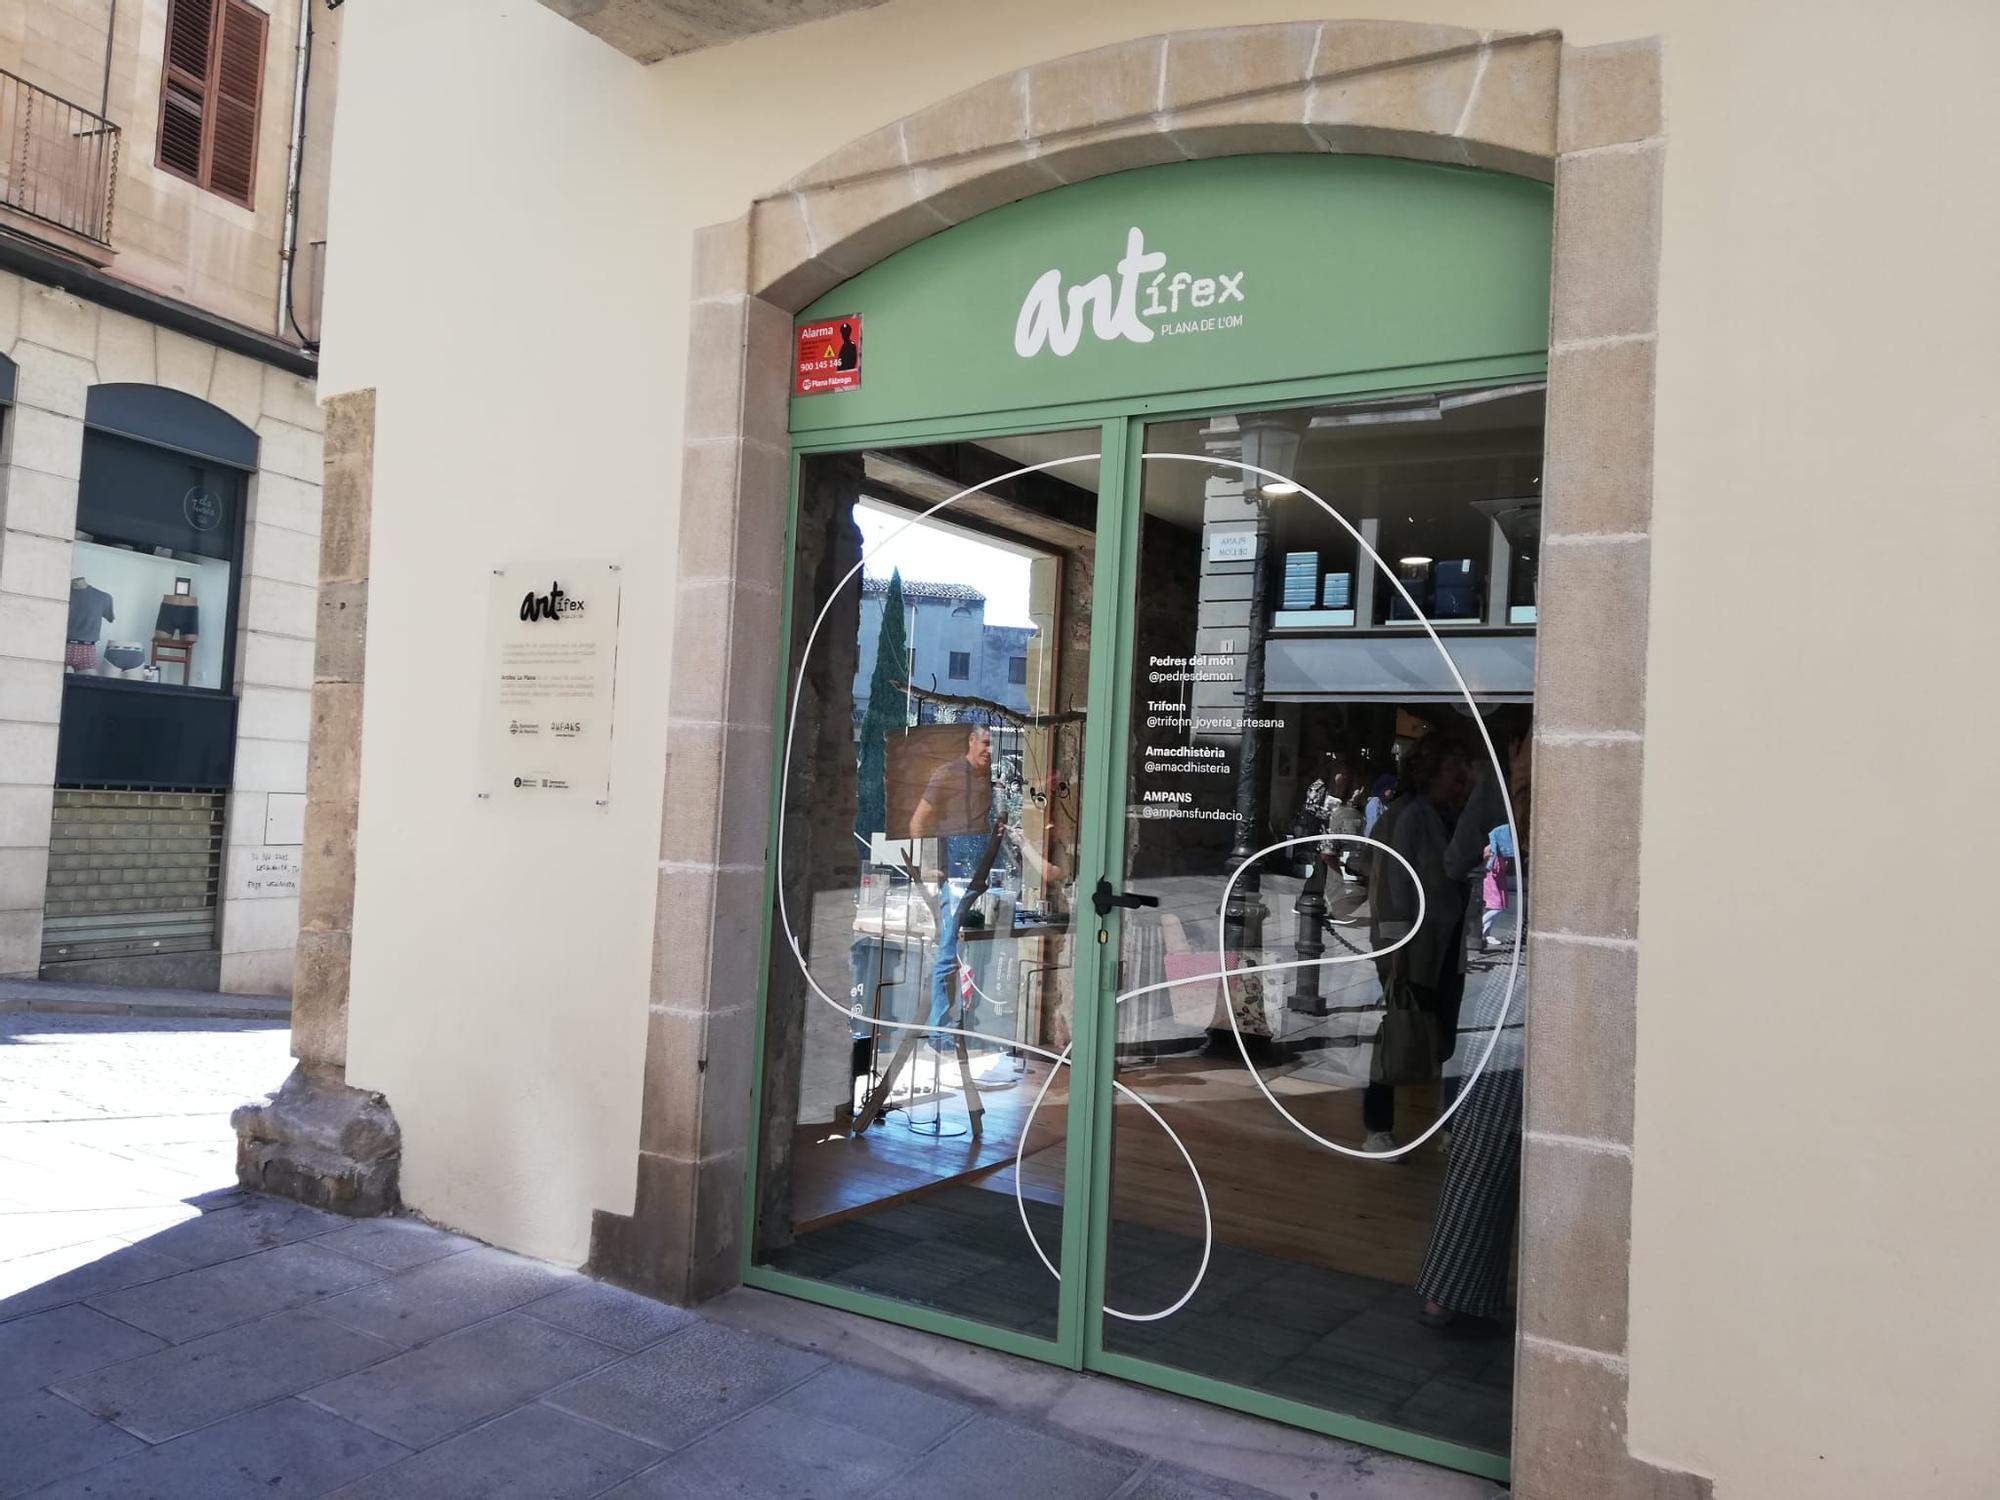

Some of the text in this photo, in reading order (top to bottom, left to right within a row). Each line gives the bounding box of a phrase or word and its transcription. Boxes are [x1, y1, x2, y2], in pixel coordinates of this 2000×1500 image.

[1161, 315, 1243, 336] PLANA DE L'OM
[802, 327, 833, 339] Alarma
[800, 362, 814, 372] 900
[1149, 655, 1234, 667] Pedres del món
[1148, 670, 1234, 683] @pedresdemon
[1147, 701, 1186, 712] Trifonn
[1146, 715, 1285, 729] @trifonn_joyeria_artesana
[1145, 745, 1226, 759] Amacdhistèria
[1144, 760, 1231, 774] @amacdhisteria
[1143, 790, 1193, 803] AMPANS
[1142, 806, 1243, 821] @ampansfundacio
